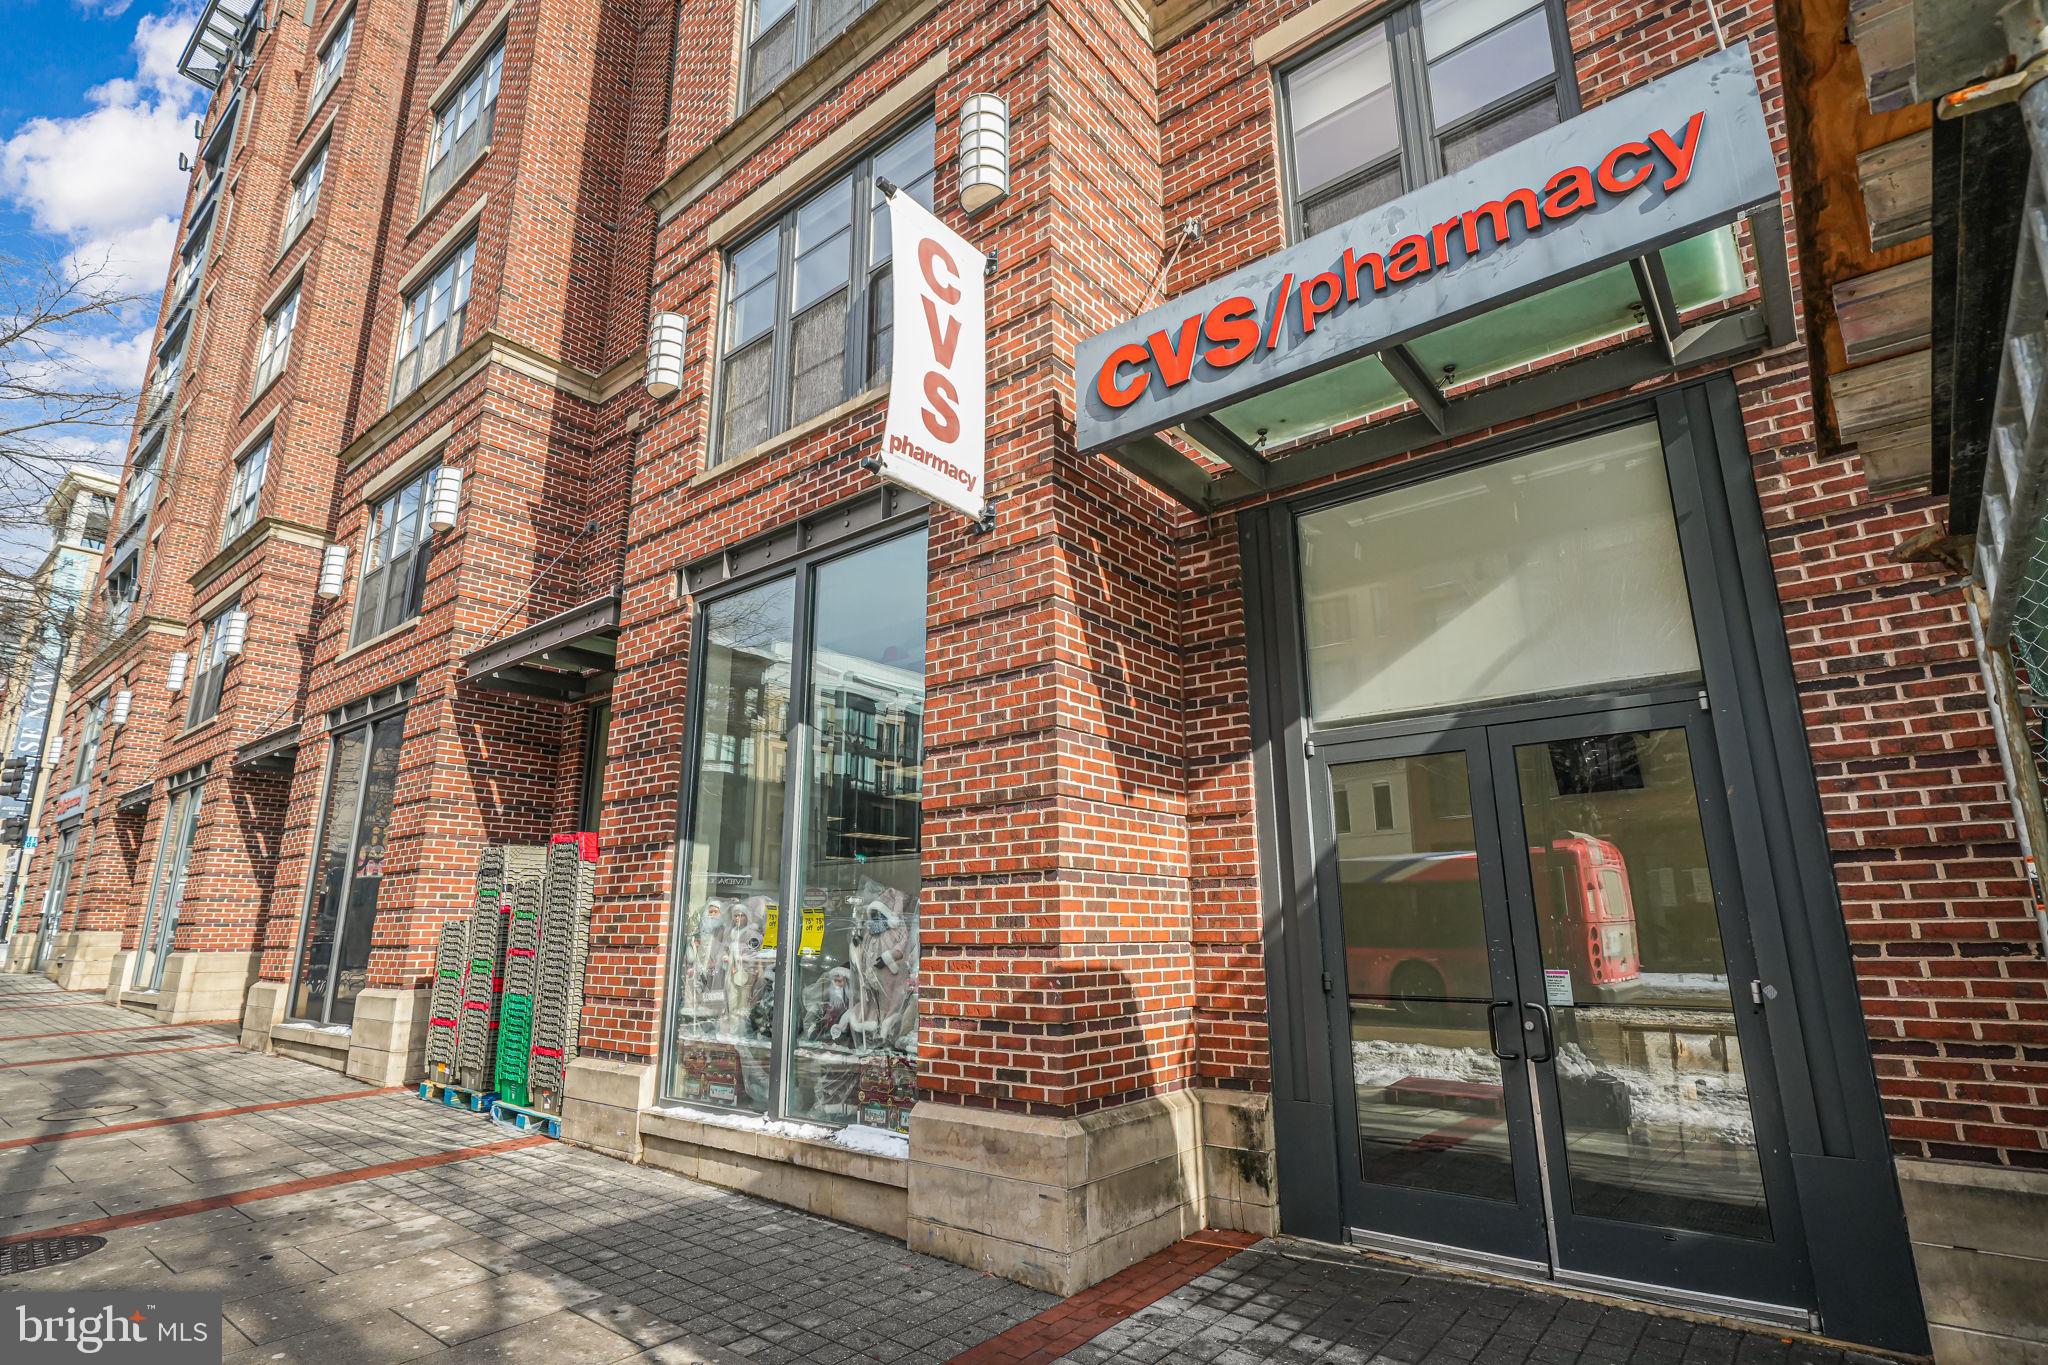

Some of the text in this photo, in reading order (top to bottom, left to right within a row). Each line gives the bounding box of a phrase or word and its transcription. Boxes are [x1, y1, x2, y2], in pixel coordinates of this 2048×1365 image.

[1097, 111, 1706, 408] CVS/pharmacy
[918, 237, 961, 444] CVS
[889, 434, 977, 491] pharmacy
[25, 668, 55, 721] NOW
